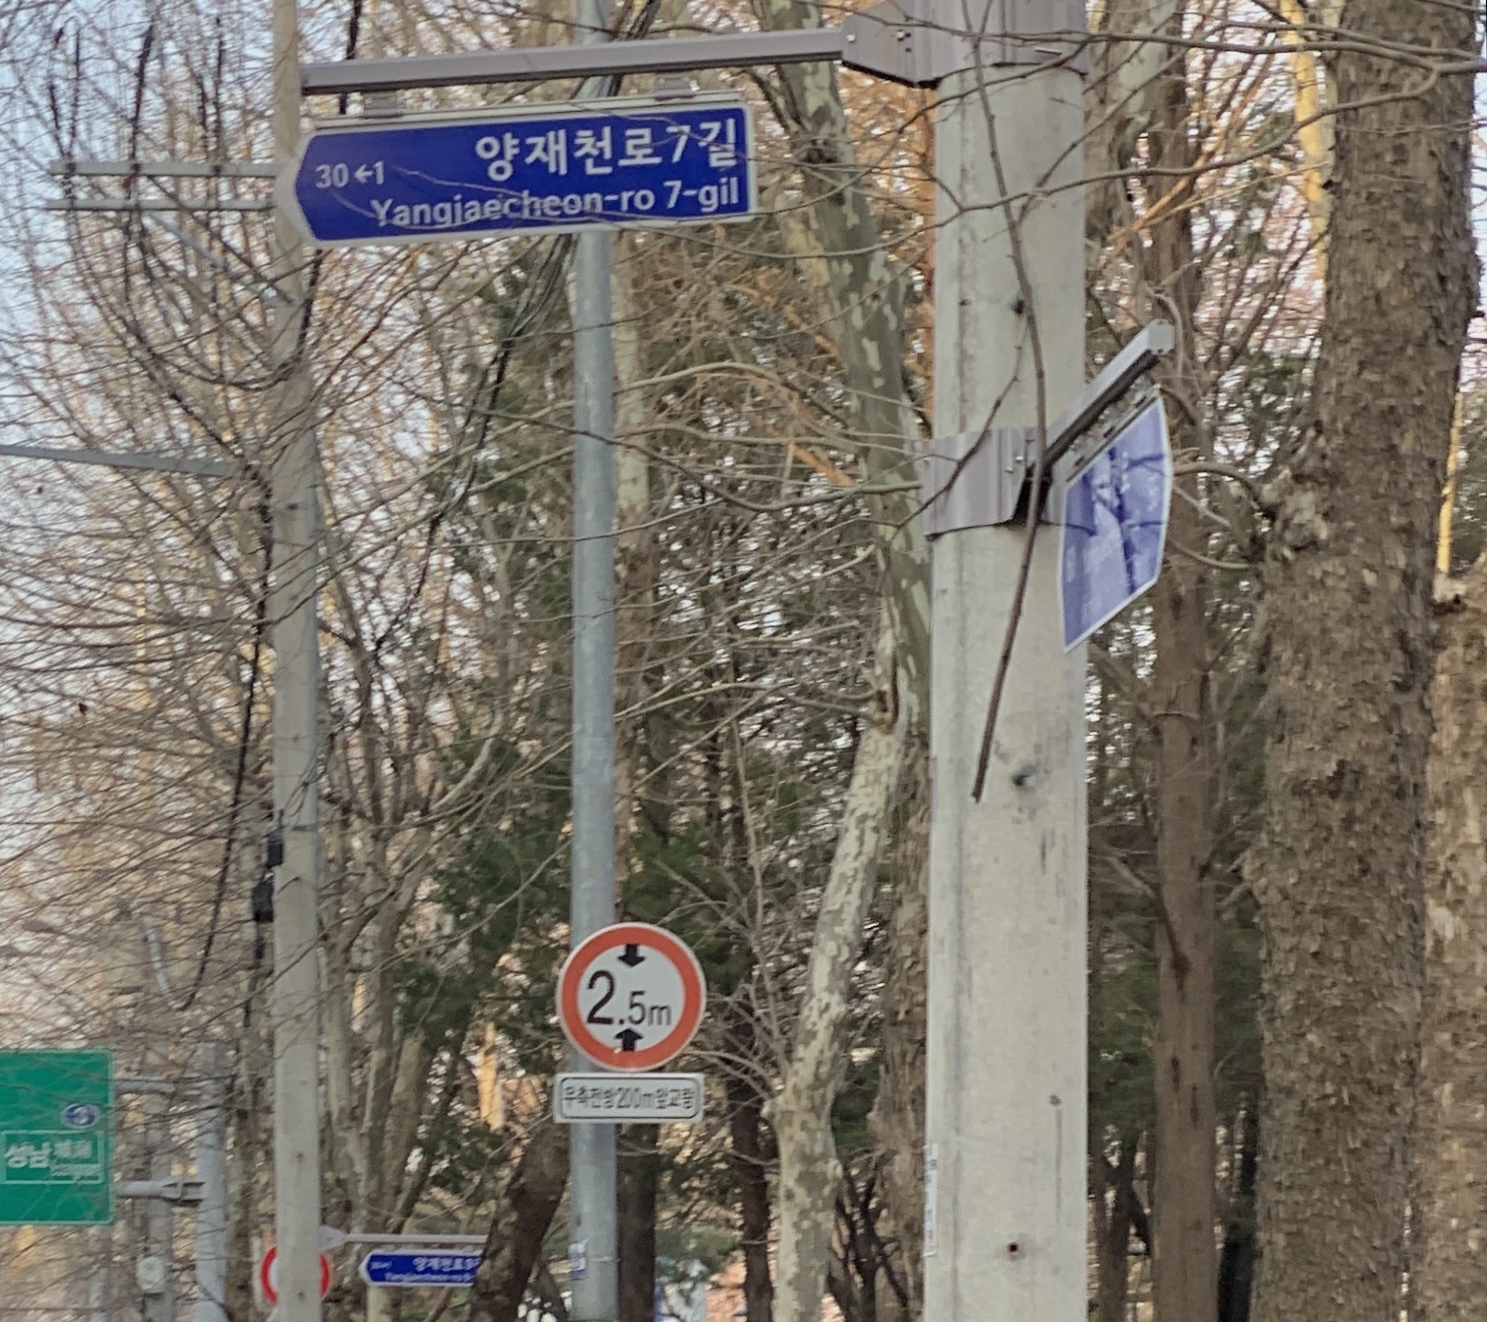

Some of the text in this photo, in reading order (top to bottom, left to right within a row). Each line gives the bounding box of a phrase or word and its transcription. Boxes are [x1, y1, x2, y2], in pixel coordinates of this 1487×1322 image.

[475, 119, 738, 182] 양재천로7길
[315, 162, 349, 189] 30
[664, 177, 739, 213] 7-gil
[586, 969, 672, 1026] 2.5m
